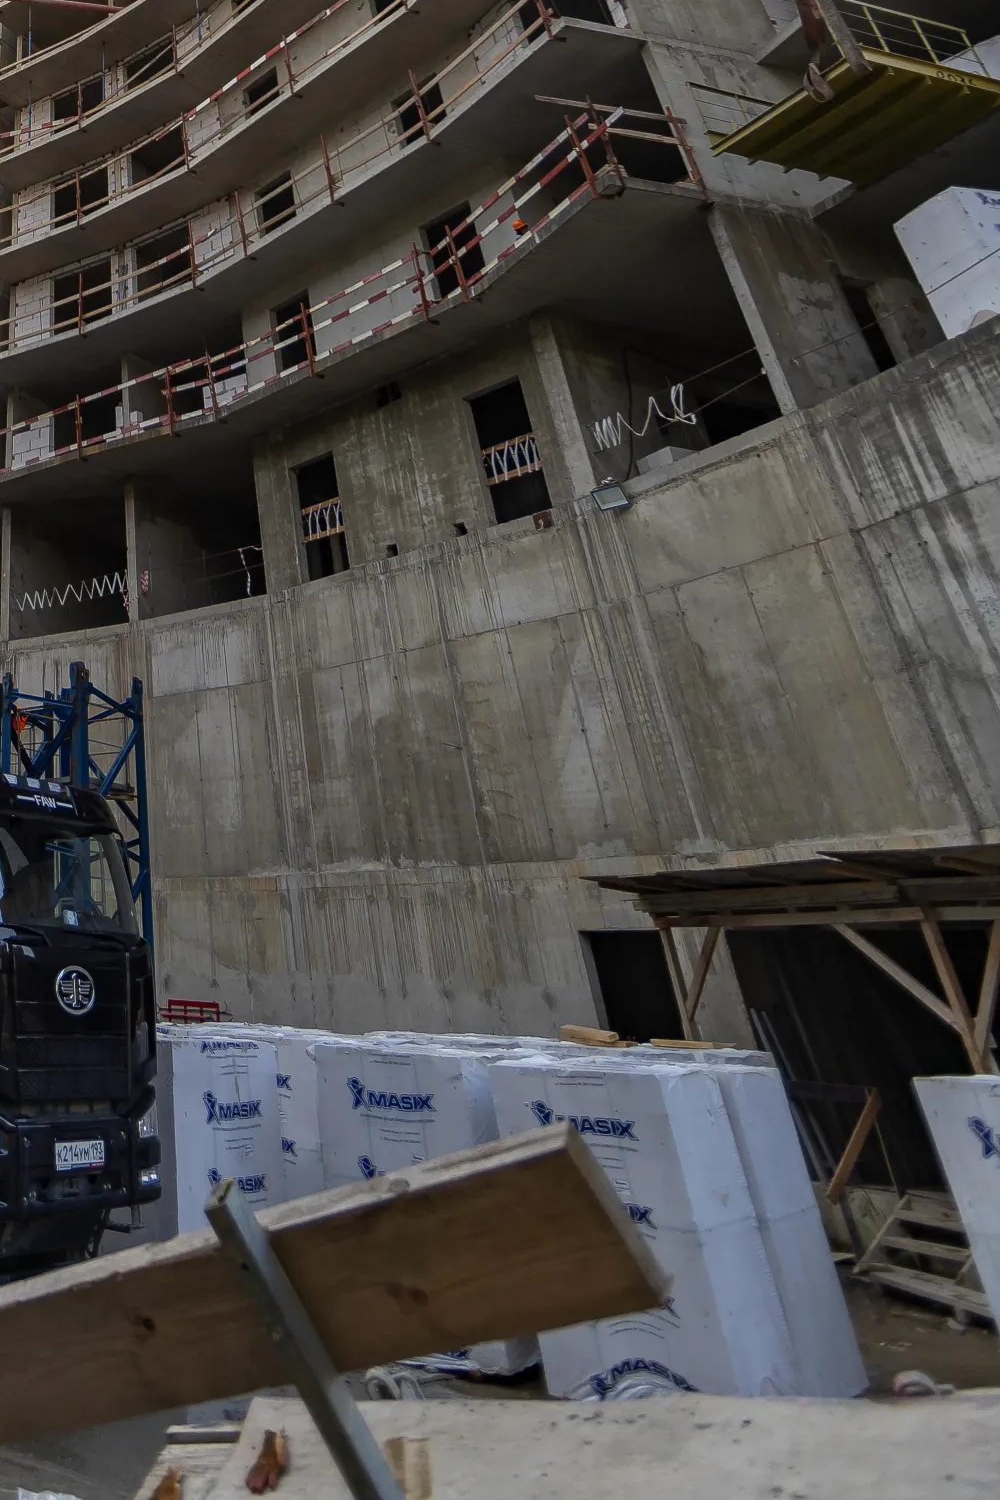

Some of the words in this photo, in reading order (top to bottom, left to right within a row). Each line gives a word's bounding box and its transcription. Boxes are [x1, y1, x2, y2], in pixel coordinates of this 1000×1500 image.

[34, 794, 57, 809] FAW
[217, 1100, 263, 1120] MASIX
[367, 1090, 437, 1112] MASIX
[236, 1174, 268, 1193] ASIX
